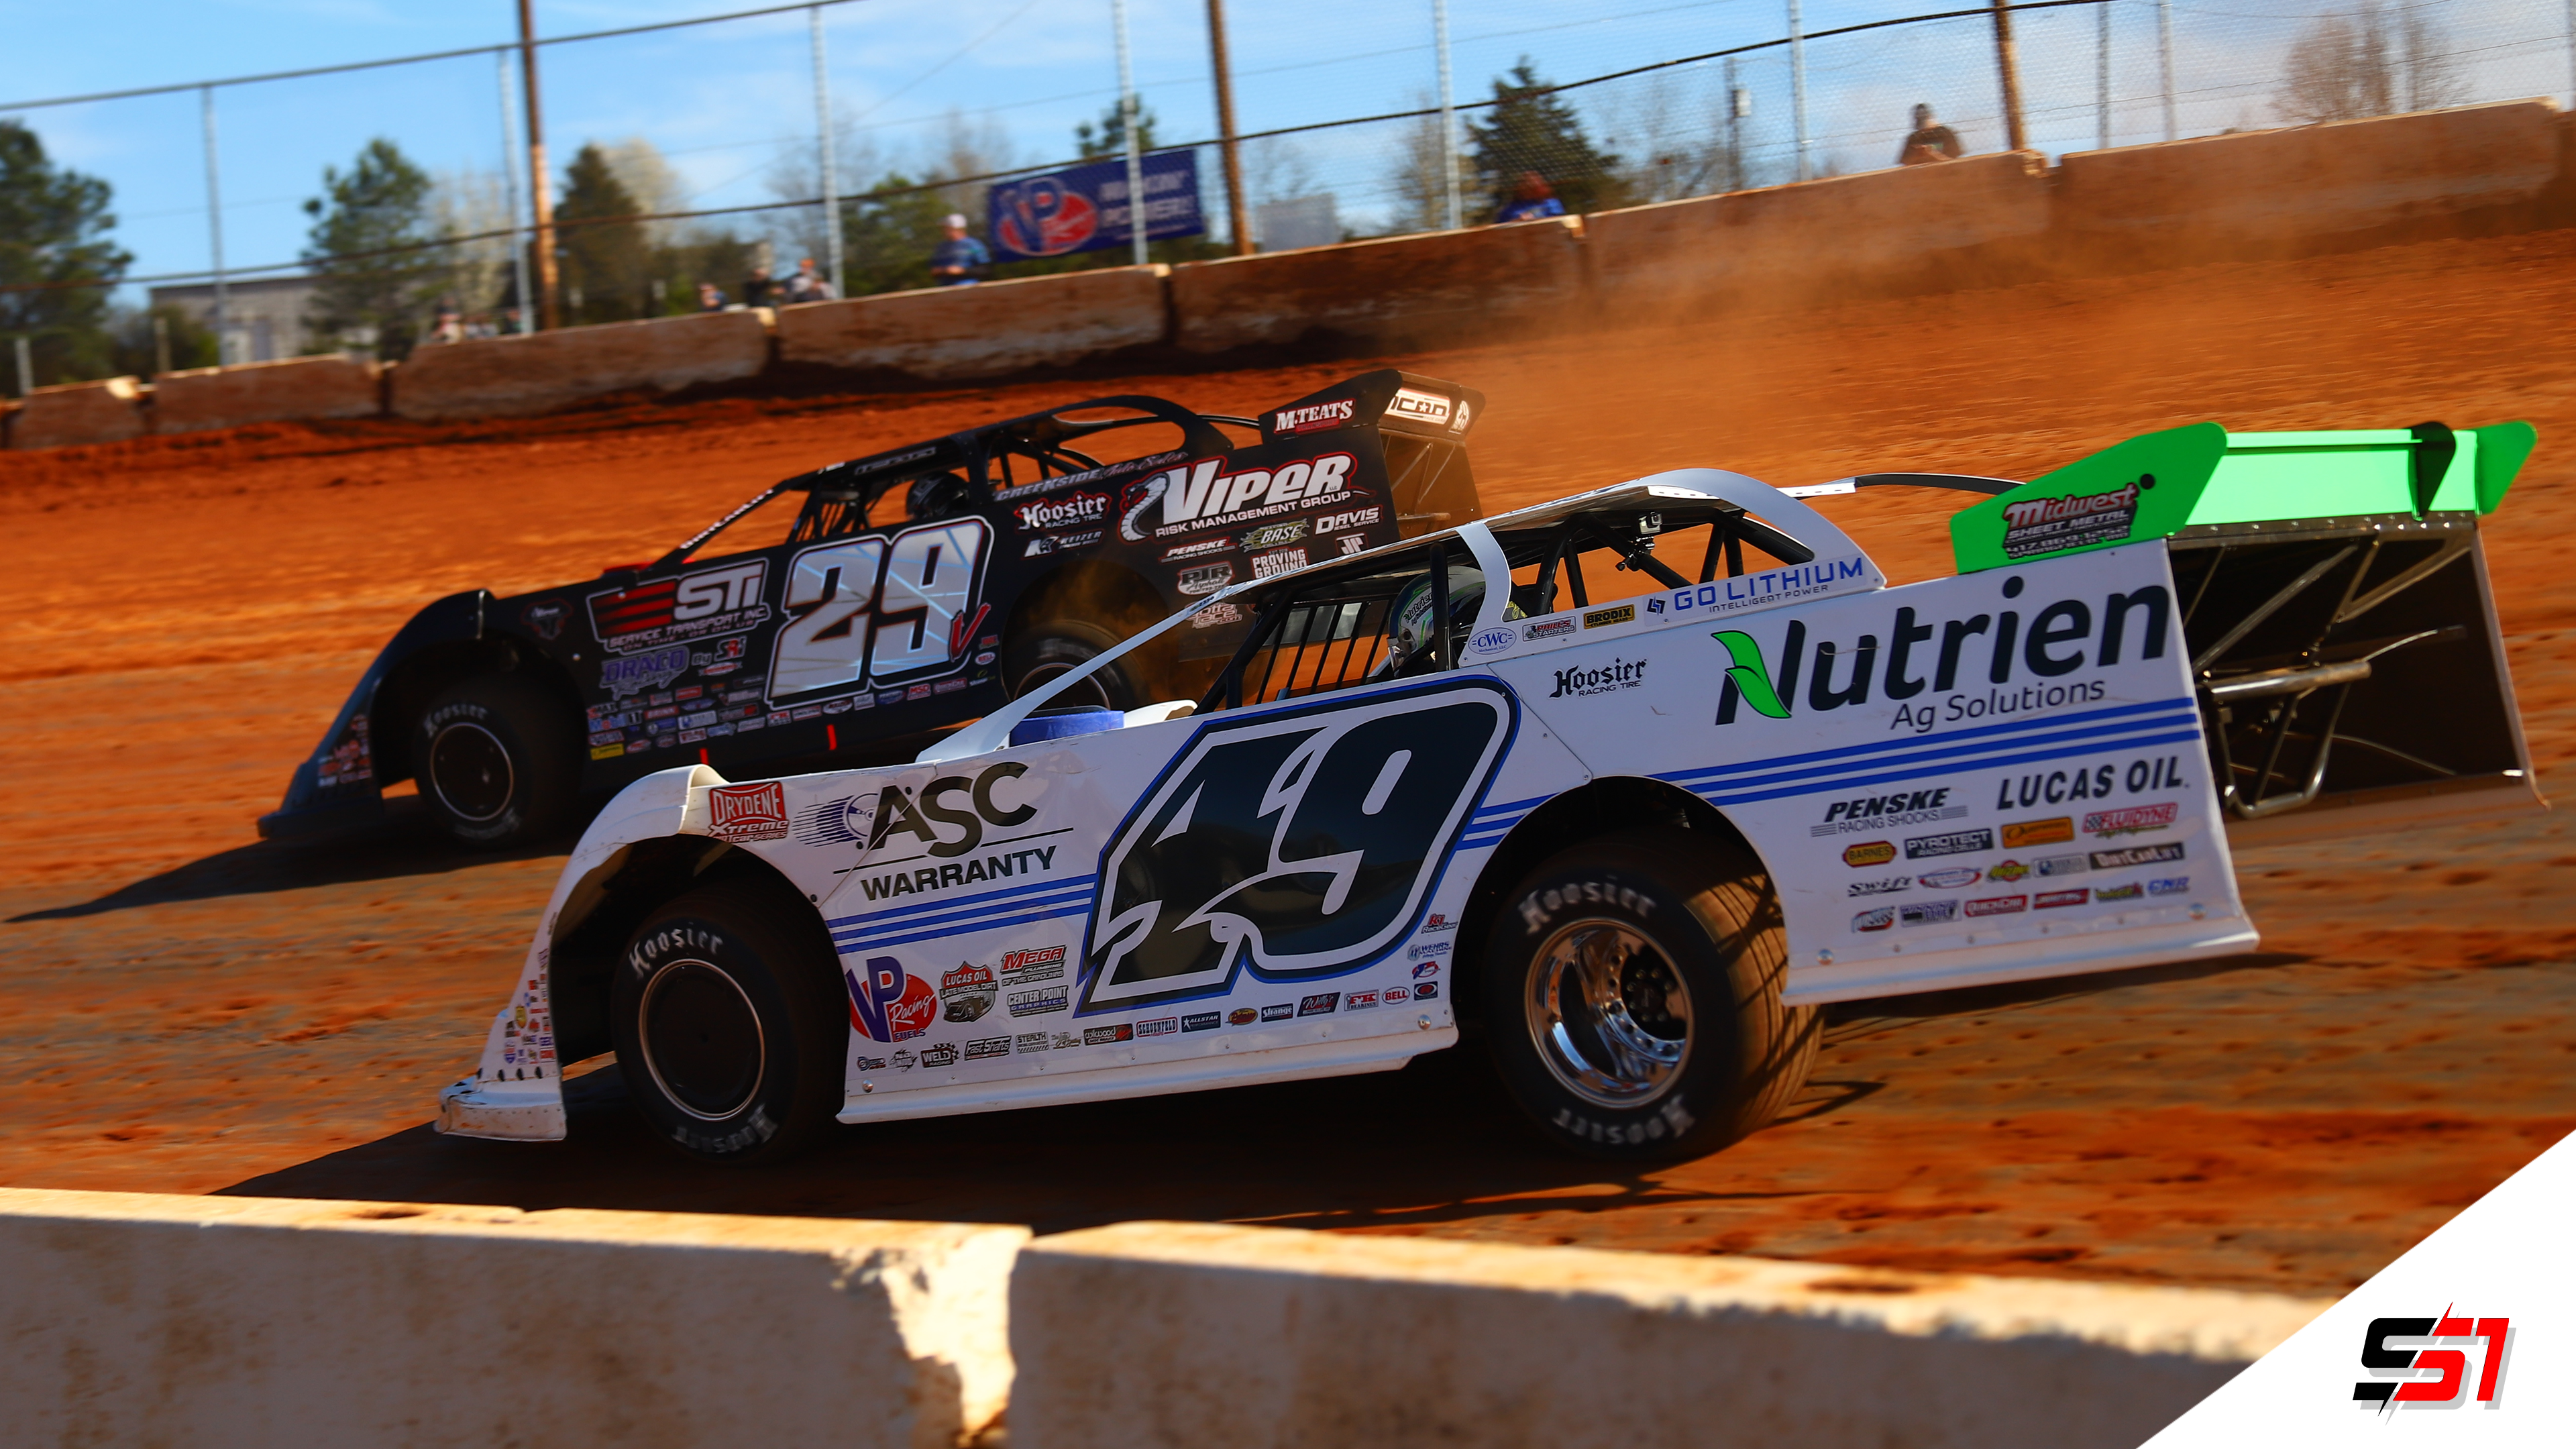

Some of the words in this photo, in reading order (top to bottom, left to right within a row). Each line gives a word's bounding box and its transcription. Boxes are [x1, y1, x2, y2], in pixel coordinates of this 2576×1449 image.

[1275, 400, 1354, 431] M.TEATS
[1018, 495, 1107, 530] Hoosier
[1155, 523, 1187, 538] RISK
[1191, 502, 1297, 530] MANAGEMENT
[1301, 491, 1351, 509] GROUP
[2003, 484, 2139, 527] Midwest
[1045, 517, 1081, 529] RACING
[1083, 513, 1102, 521] TIRE
[1316, 507, 1381, 535] DAVIS
[1353, 518, 1380, 528] SERVICE
[2008, 521, 2067, 539] SHEET
[2069, 510, 2129, 528] METAL
[1060, 531, 1103, 545] KEIZER
[1260, 524, 1303, 544] BASE
[1167, 539, 1228, 557] PENSKE
[1173, 551, 1198, 561] RACING
[1199, 547, 1223, 557] SHOCKS
[1252, 550, 1305, 569] PROVING
[1254, 559, 1307, 578] GROUND
[674, 562, 764, 621] STI
[1674, 585, 1716, 611] GO
[1727, 557, 1864, 600] LITHIUM
[1709, 594, 1781, 613] INTELLIGENT
[1785, 584, 1829, 598] POWER
[770, 521, 984, 698] 29
[1586, 606, 1632, 624] BRODIX
[665, 612, 741, 636] TRANSPORT
[1534, 625, 1574, 638] STARTERS
[1477, 632, 1508, 648] CWC
[1711, 576, 2170, 725] Nutrien
[606, 649, 686, 682] DRACO
[1549, 657, 1647, 698] Hoosier
[1578, 685, 1617, 697] RACING
[1620, 680, 1642, 689] TIRE
[1890, 702, 1935, 733] Ag
[1945, 679, 2105, 722] Solutions
[1996, 764, 2116, 811] LUCAS
[2126, 755, 2184, 794] OIL
[712, 784, 782, 825] DRYDENE
[868, 761, 1038, 858] ASC
[1825, 787, 1951, 822] PENSKE
[1838, 816, 1888, 835] RACING
[1890, 810, 1940, 828] SHOCKS
[2100, 805, 2174, 829] FLUIDYNE
[753, 832, 788, 841] SERIES
[1089, 688, 1510, 1004] 49
[1907, 830, 1990, 851] PYROTECT
[1849, 846, 1891, 860] BARNES
[1917, 848, 1952, 857] RACING
[861, 845, 1057, 902] WARRANTY
[1849, 876, 1912, 894] Swift
[1518, 875, 1658, 934] Hoosier
[1422, 921, 1458, 933] RaceGear
[1428, 914, 1445, 926] K1
[629, 923, 723, 979] Hoosier
[1421, 941, 1450, 952] WEHRS
[1002, 947, 1065, 971] MEGA
[1024, 962, 1063, 973] PLUMBING
[946, 973, 973, 986] LUCAS
[973, 971, 988, 982] OIL
[1012, 976, 1027, 984] THE
[1027, 971, 1064, 981] CAROLINAS
[845, 955, 906, 1043] VP
[940, 987, 957, 998] LATE
[957, 984, 981, 994] MODEL
[981, 981, 997, 991] DIRT
[1008, 991, 1040, 1006] CENTER
[1042, 986, 1068, 1002] POINT
[1385, 989, 1408, 1002] BELL
[890, 994, 936, 1029] Racing
[1011, 998, 1067, 1010] GRAPHICS
[1263, 1006, 1293, 1018] Strange
[1138, 1019, 1176, 1034] SCHOENFELD
[1189, 1014, 1219, 1023] ALLSTAR
[894, 1028, 926, 1040] FUELS
[1017, 1032, 1046, 1043] STEALTH
[1085, 1026, 1117, 1039] wilwood
[966, 1040, 985, 1055] Fast
[984, 1037, 1010, 1052] Shafts
[922, 1049, 951, 1063] WELD
